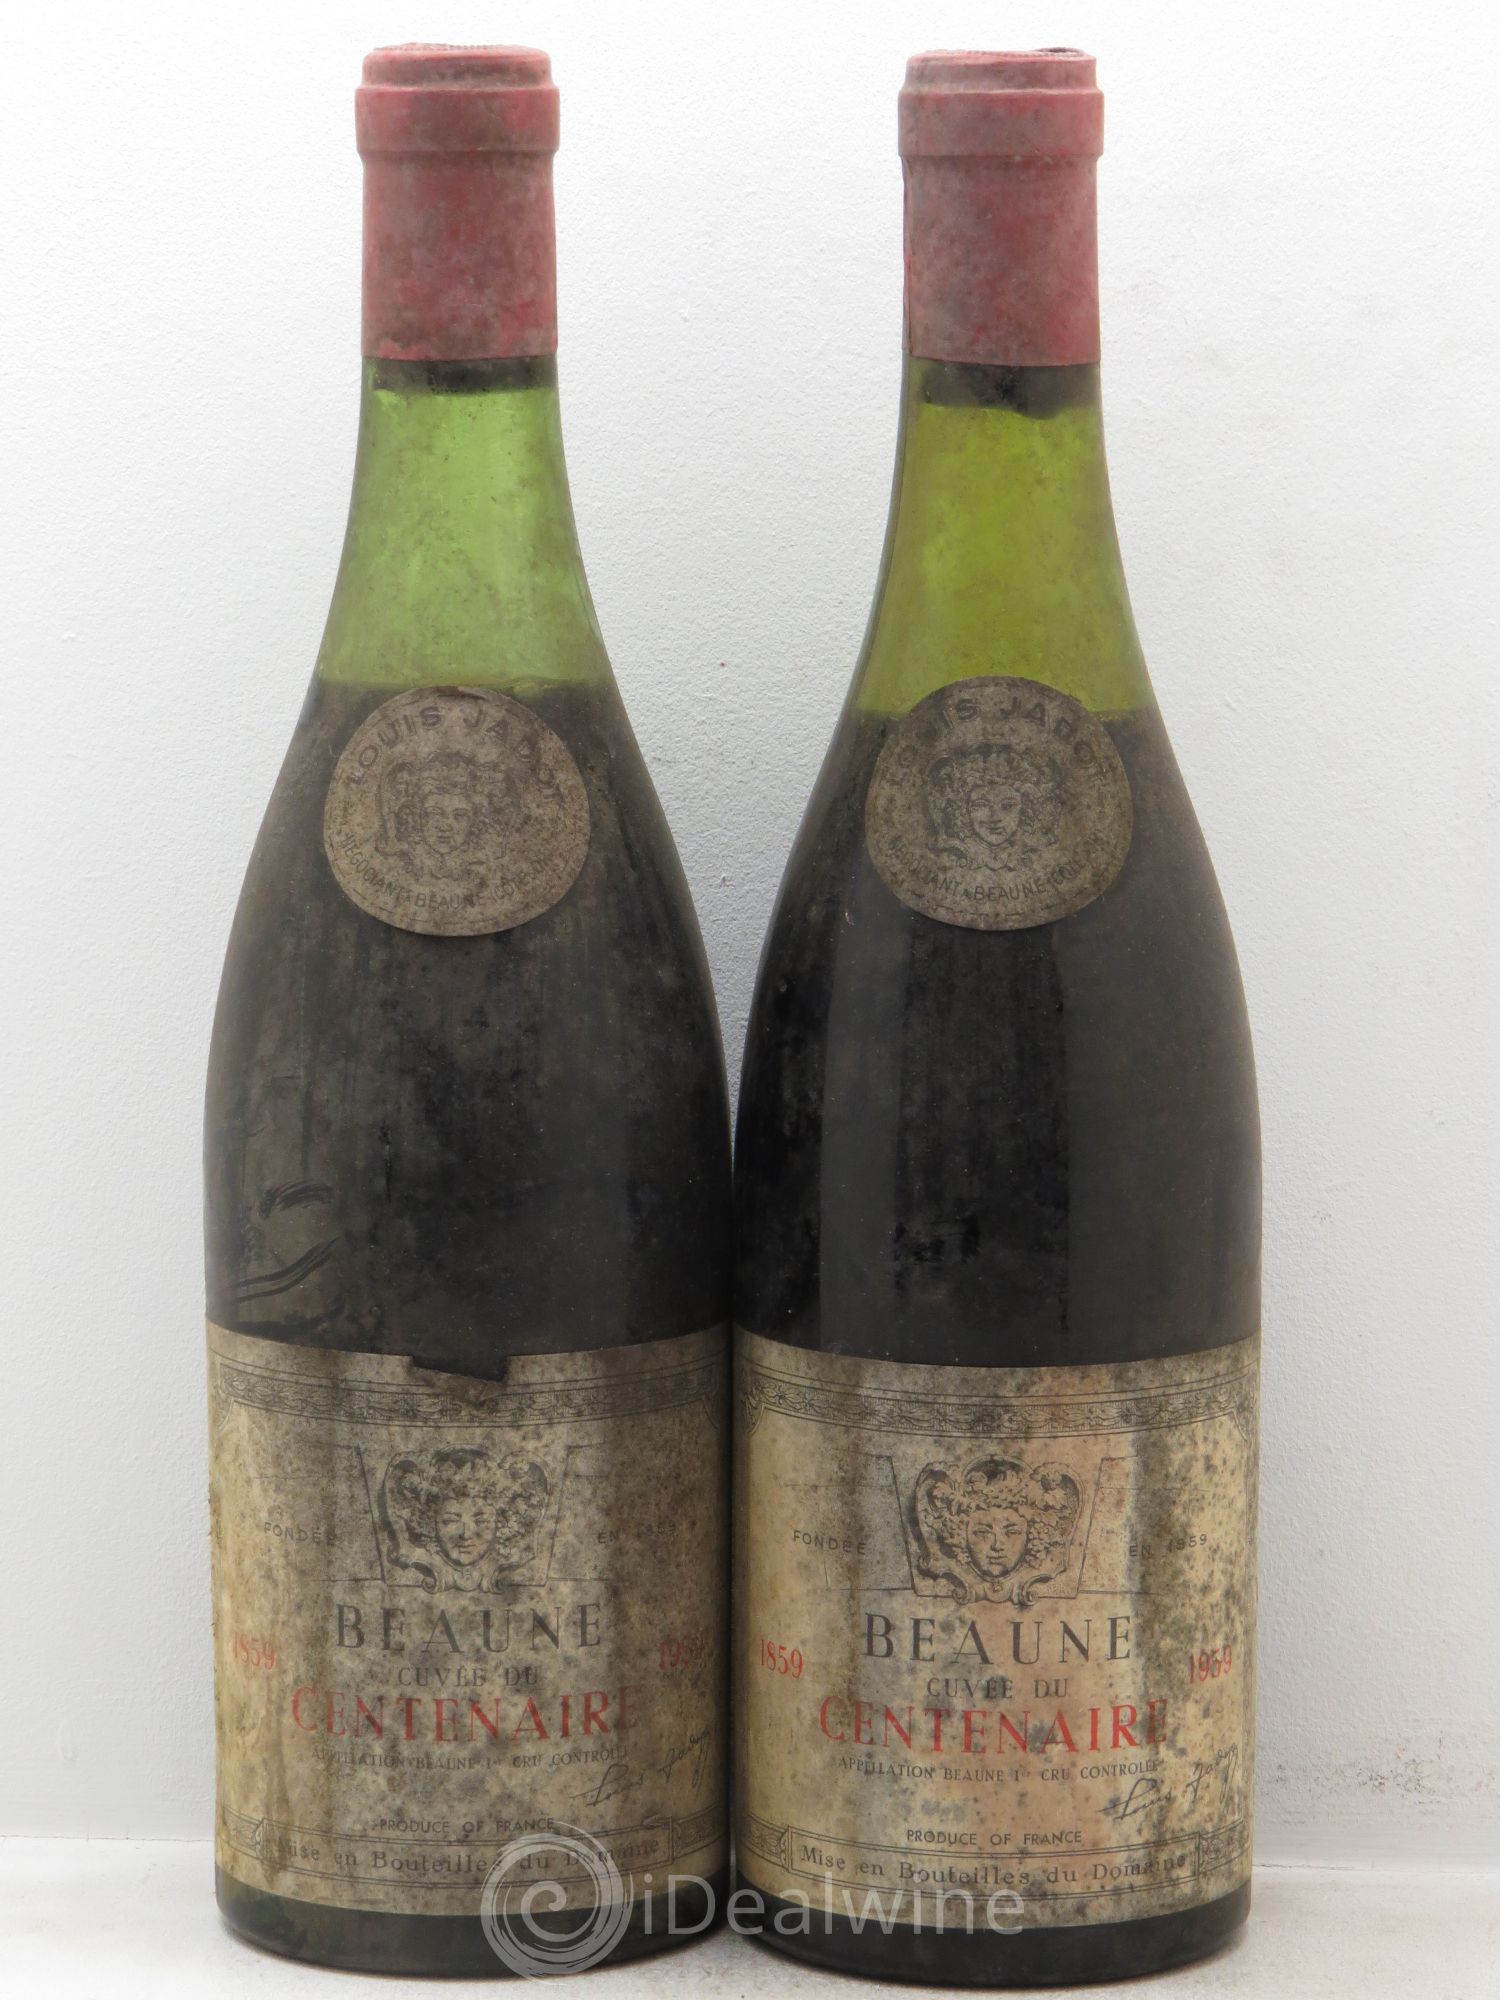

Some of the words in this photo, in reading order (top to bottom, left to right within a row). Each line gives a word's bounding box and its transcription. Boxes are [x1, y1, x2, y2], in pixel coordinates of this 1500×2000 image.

[346, 705, 443, 787] LOUIS
[972, 880, 1048, 902] BEAUNE
[1128, 1544, 1153, 1560] EN
[1166, 1533, 1208, 1553] 1859
[335, 1603, 601, 1655] BEAUNE
[863, 1612, 1132, 1666] BEAUNE
[232, 1631, 277, 1671] 1859
[759, 1638, 805, 1680] 1859
[1188, 1644, 1234, 1685] 1959
[503, 1665, 540, 1687] DU
[1034, 1677, 1069, 1699] DU
[290, 1683, 642, 1747] CENTENAIRE
[819, 1695, 1169, 1755] CENTENAIRE
[512, 1753, 542, 1769] CRU
[838, 1756, 935, 1779] APPELLATION
[943, 1767, 1005, 1782] BEAUNE
[1041, 1767, 1071, 1782] CRU
[378, 1818, 450, 1834] PRODUCE
[462, 1820, 485, 1835] OF
[495, 1817, 555, 1833] FRANCE
[906, 1829, 978, 1846] PRODUCE
[989, 1833, 1012, 1847] OF
[1022, 1831, 1083, 1846] FRANCE
[333, 1852, 359, 1867] en
[519, 1853, 550, 1871] du
[801, 1845, 847, 1871] Mise
[859, 1863, 886, 1877] en
[899, 1861, 1031, 1886] Bouteilles
[1046, 1865, 1078, 1884] du
[1091, 1853, 1187, 1881] Domaine
